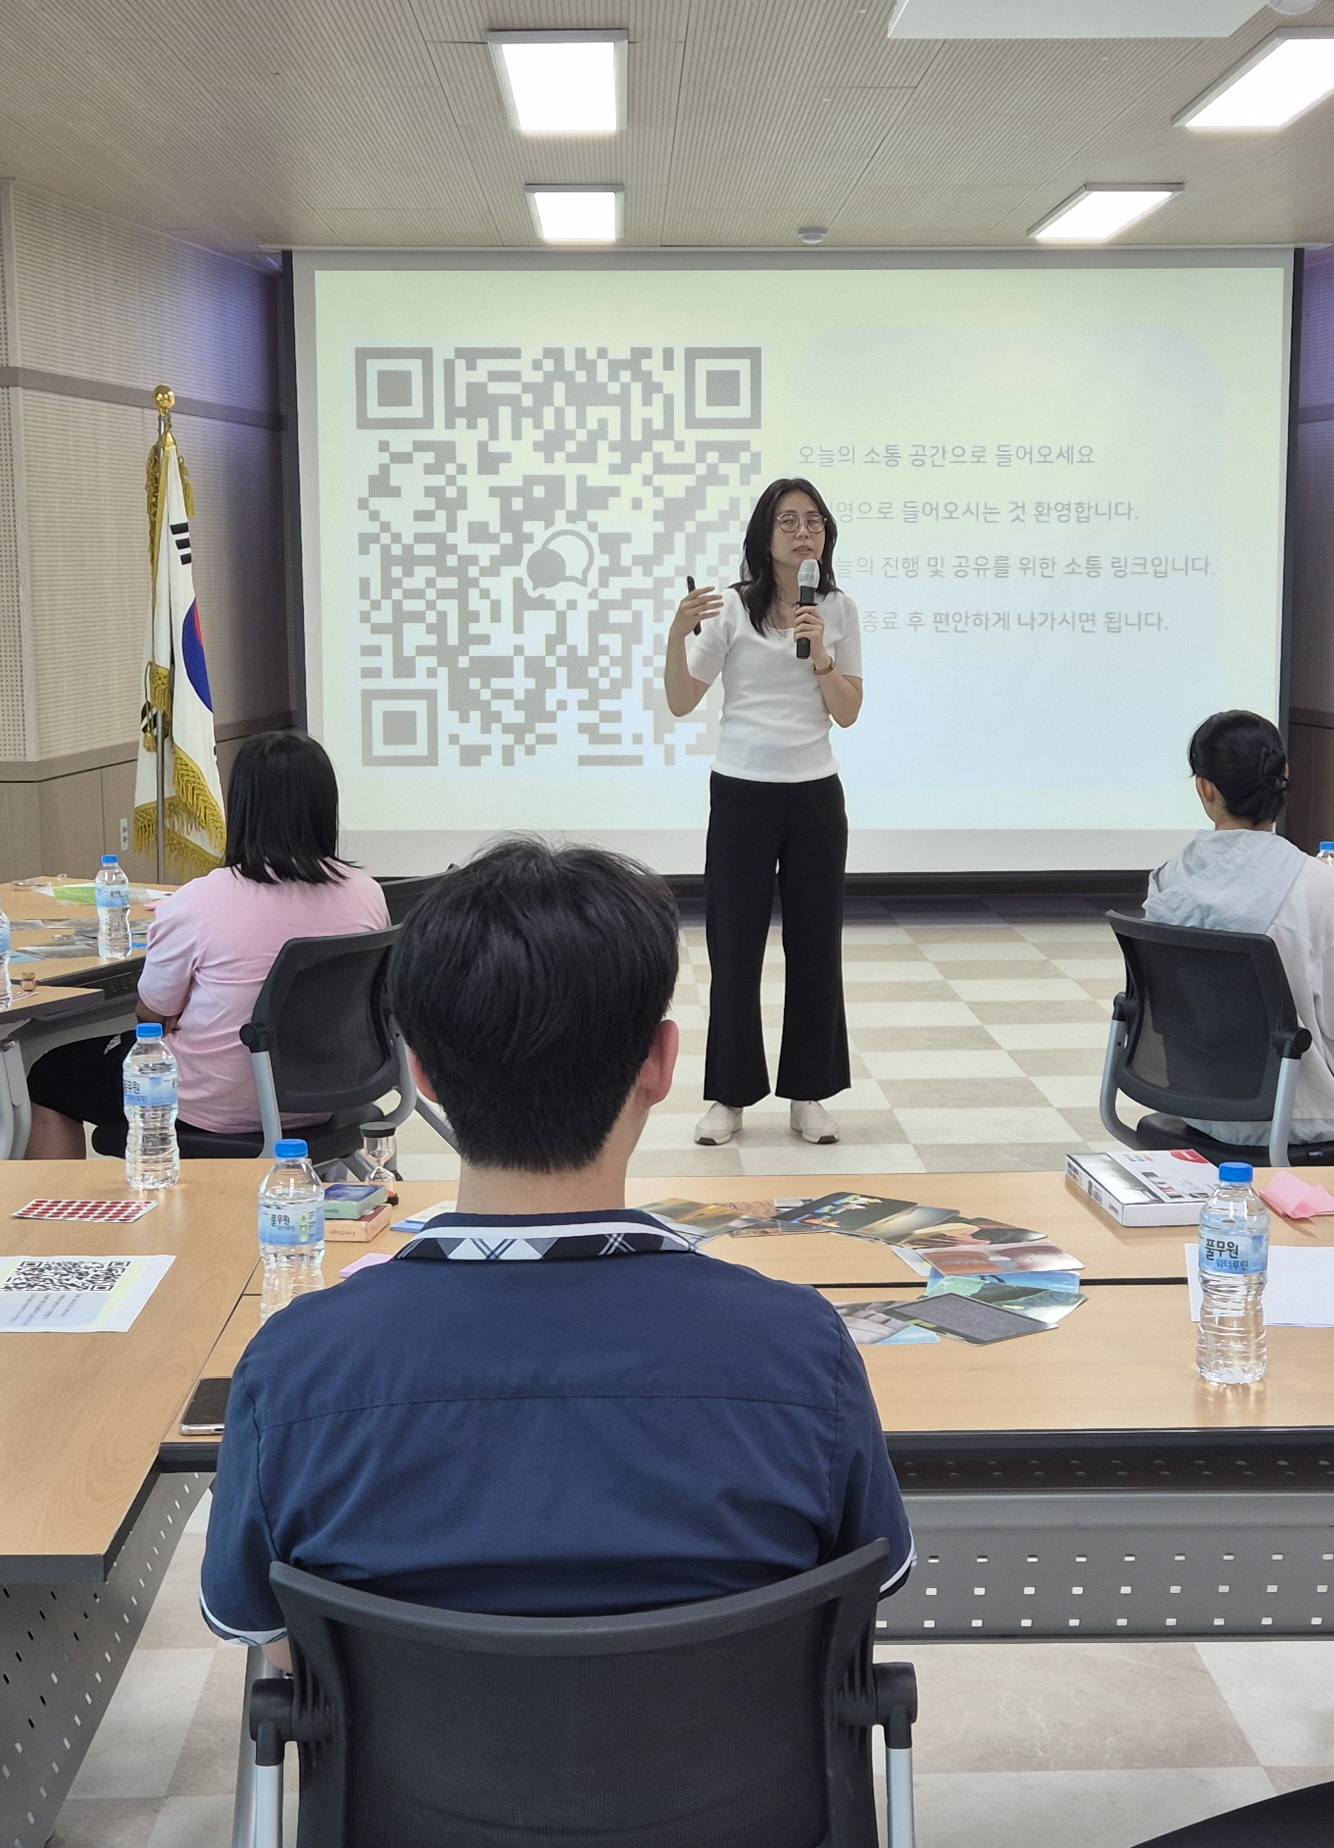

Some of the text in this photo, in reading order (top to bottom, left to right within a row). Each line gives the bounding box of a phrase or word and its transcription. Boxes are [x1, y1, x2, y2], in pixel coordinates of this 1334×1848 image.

[798, 445, 1095, 468] 오늘의 소통 공간으로 들어오세요
[830, 500, 1140, 524] 명으로 들어오시는 것 환영합니다.
[835, 556, 1216, 579] 늘의 진행 및 공유를 위한 소통 링크입니다.
[861, 611, 1169, 634] 종료 후 편안하게 나가시면 됩니다.
[1205, 1238, 1239, 1261] 풀무원
